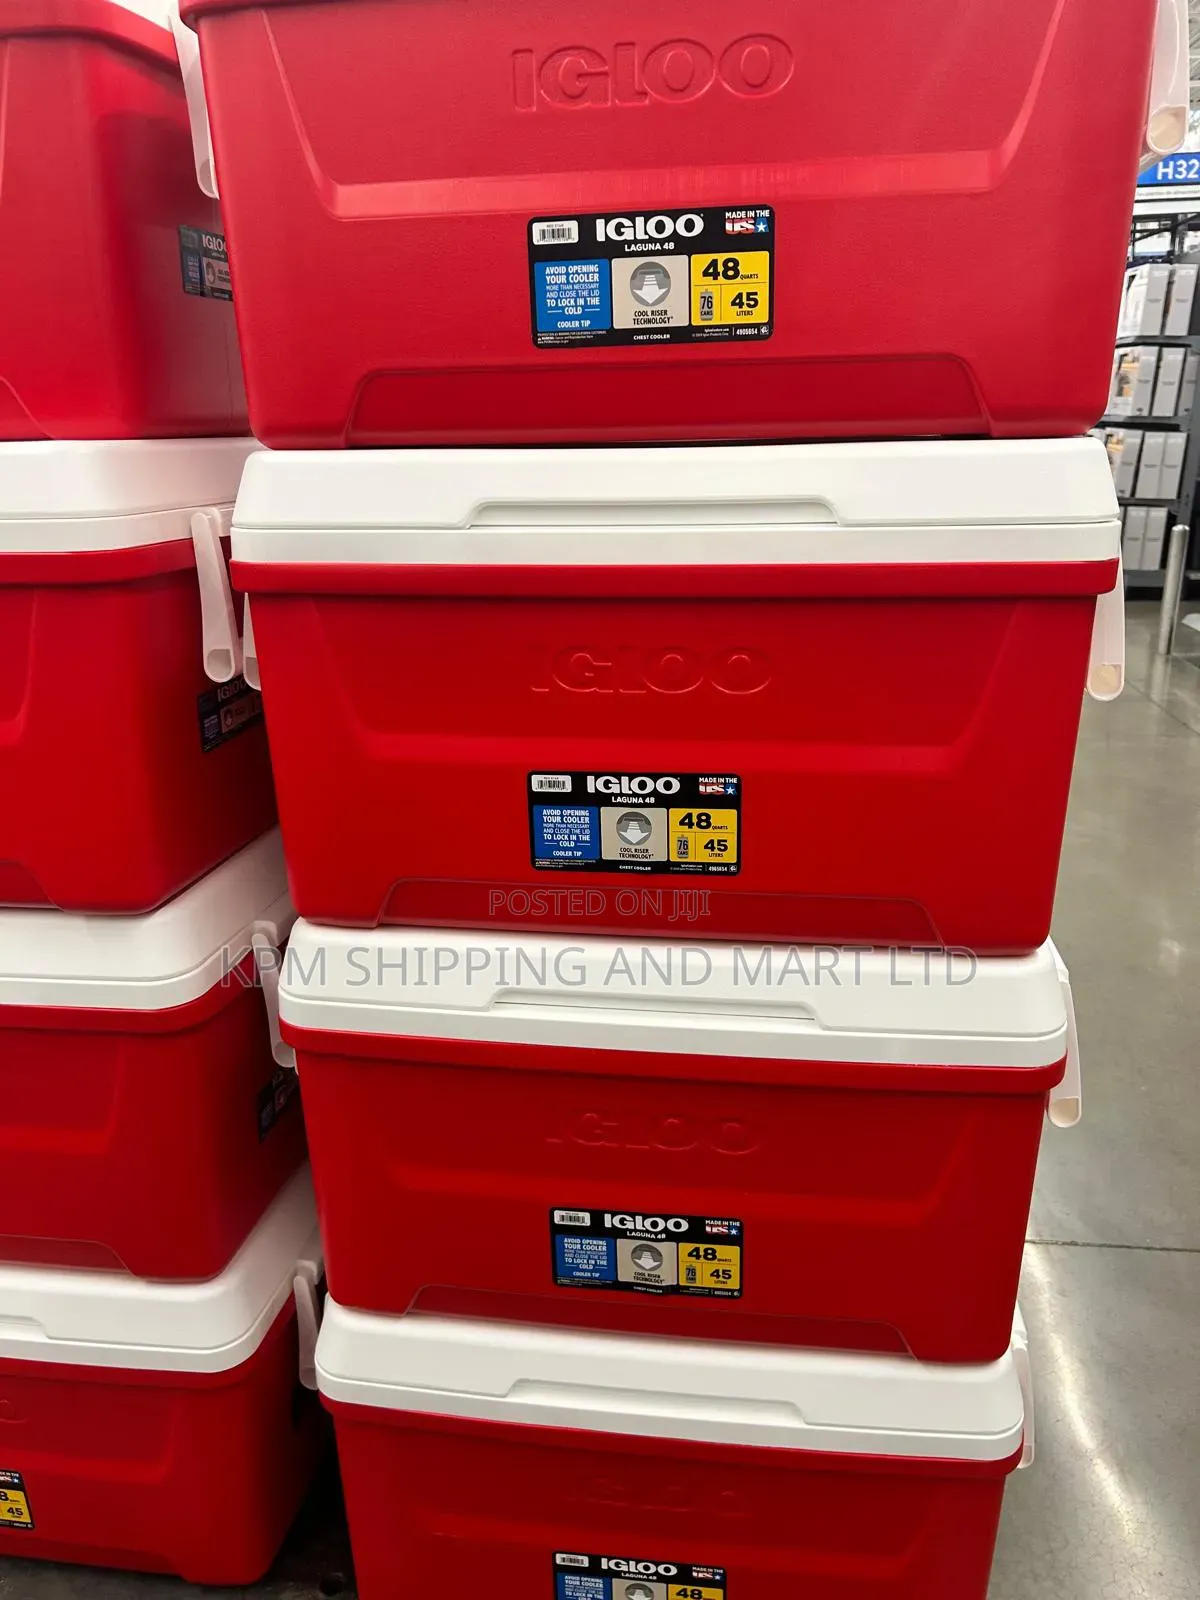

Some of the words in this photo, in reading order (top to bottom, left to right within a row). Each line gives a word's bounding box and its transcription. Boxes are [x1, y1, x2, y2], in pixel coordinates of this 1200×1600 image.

[511, 32, 795, 113] IGLOO
[1157, 158, 1199, 180] H32
[725, 211, 746, 219] MADE
[747, 210, 755, 218] IN
[756, 209, 770, 217] THE
[595, 213, 704, 242] IGLOO
[625, 243, 662, 252] LAGUNA
[662, 242, 675, 250] 48
[545, 266, 567, 274] AVOID
[568, 264, 599, 273] OPENING
[701, 257, 741, 281] 48
[545, 275, 567, 284] YOUR
[568, 273, 599, 282] COOLER
[590, 289, 600, 297] LID
[546, 299, 556, 307] TO
[558, 299, 576, 307] LOCK
[587, 297, 600, 305] THE
[700, 295, 713, 309] 76
[730, 292, 759, 309] 45
[564, 307, 583, 315] COLD
[634, 310, 650, 318] COOL
[650, 309, 668, 317] RISER
[557, 321, 580, 329] COOLER
[581, 320, 591, 328] TIP
[529, 645, 772, 695] IGLOO
[586, 775, 681, 795] IGLOO
[611, 796, 644, 804] LAGUNA
[644, 796, 655, 804] 48
[542, 815, 562, 823] YOUR
[563, 816, 590, 824] COOLER
[678, 811, 712, 830] 48
[677, 839, 689, 850] 76
[703, 838, 729, 852] 45
[604, 1213, 689, 1233] IGLOO
[626, 1231, 656, 1239] LAGUNA
[687, 1246, 717, 1261] 48
[709, 1268, 732, 1280] 45
[0, 1490, 9, 1501] 8
[7, 1506, 24, 1516] 45
[601, 1557, 678, 1576] IGLOO
[621, 1572, 648, 1580] LAGUNA
[676, 1587, 703, 1600] 48
